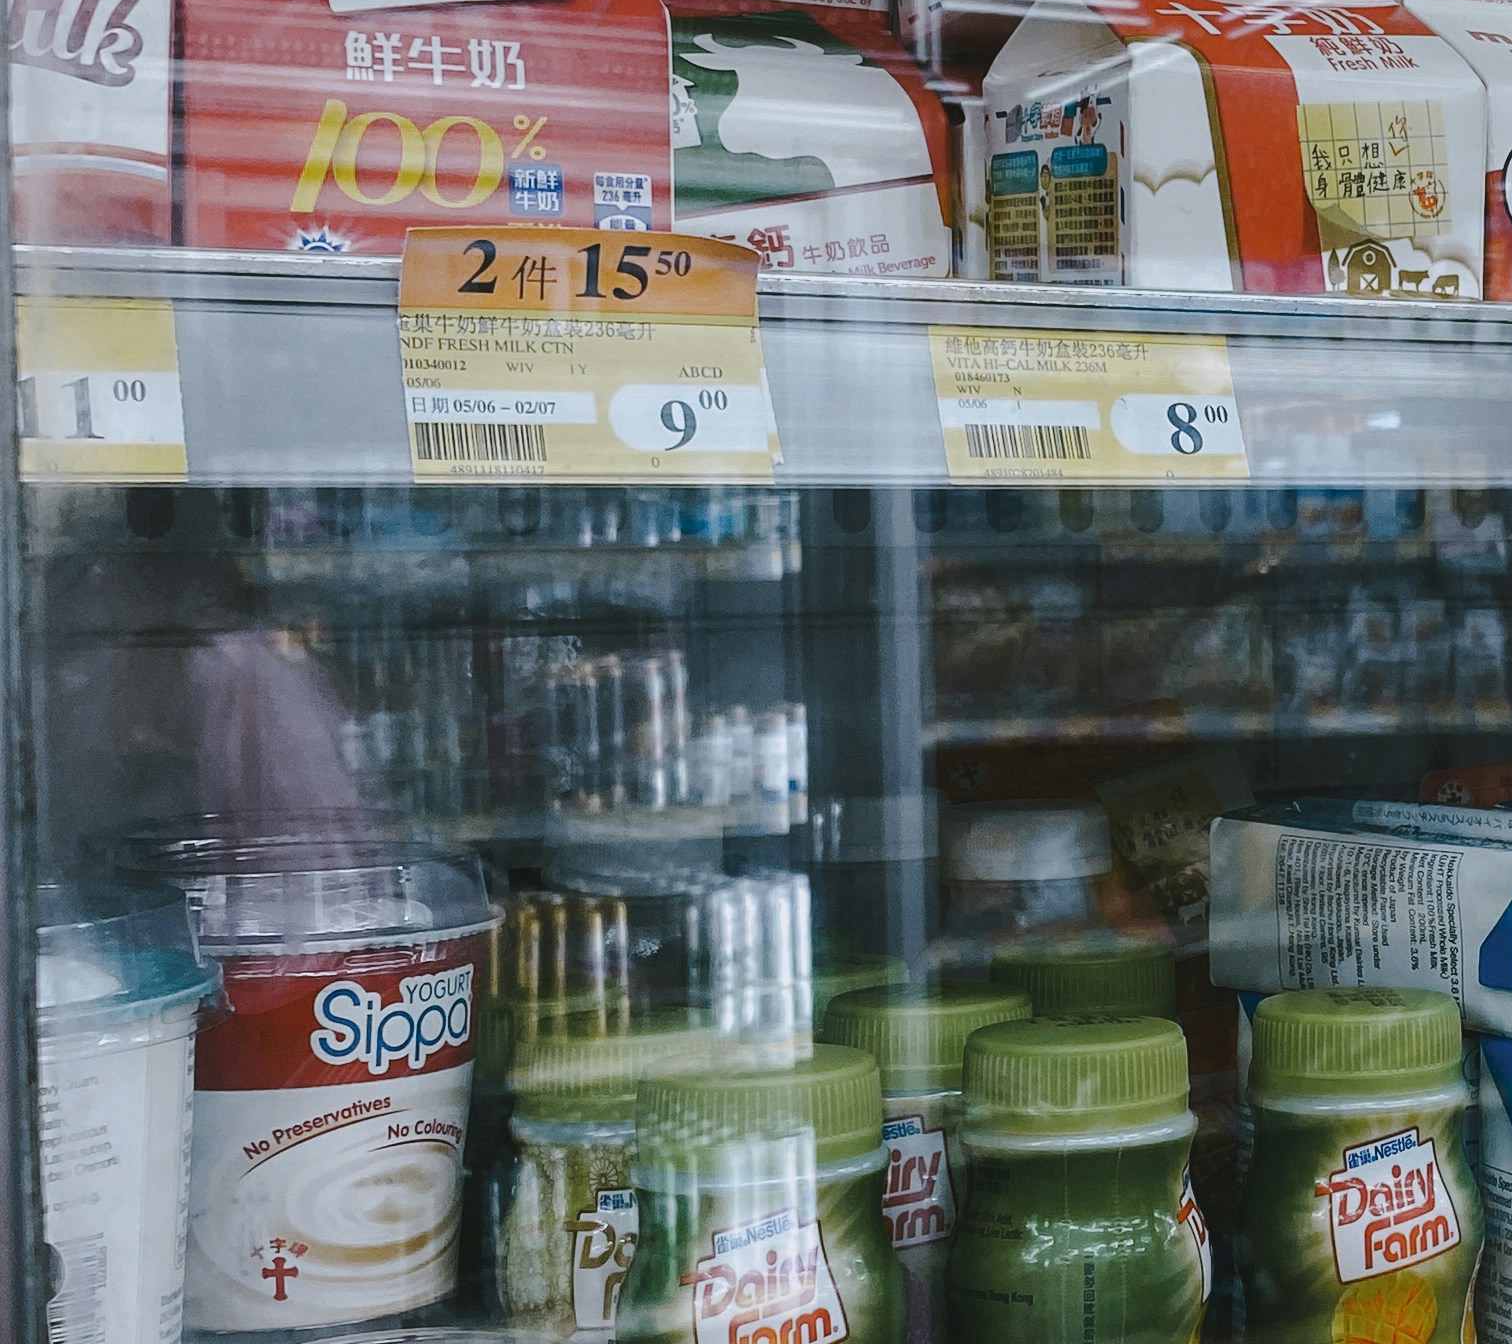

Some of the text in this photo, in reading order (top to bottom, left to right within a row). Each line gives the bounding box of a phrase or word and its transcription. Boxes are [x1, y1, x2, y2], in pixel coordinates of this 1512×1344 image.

[345, 30, 527, 91] 鮮牛奶
[1327, 54, 1420, 72] Fresh Milk
[457, 239, 558, 301] 2 件
[438, 339, 574, 354] FRESH MILK CTN
[947, 357, 1108, 374] VITA MILK 236M
[453, 398, 556, 417] 05/06 02/07
[1167, 402, 1229, 455] 8 00
[405, 970, 471, 1005] YOGURT
[317, 988, 470, 1067] Sippa
[243, 1095, 392, 1159] No Preservatives
[1313, 1161, 1437, 1231] Dairy
[1361, 1213, 1450, 1271] Farm
[682, 1247, 819, 1318] Dairy
